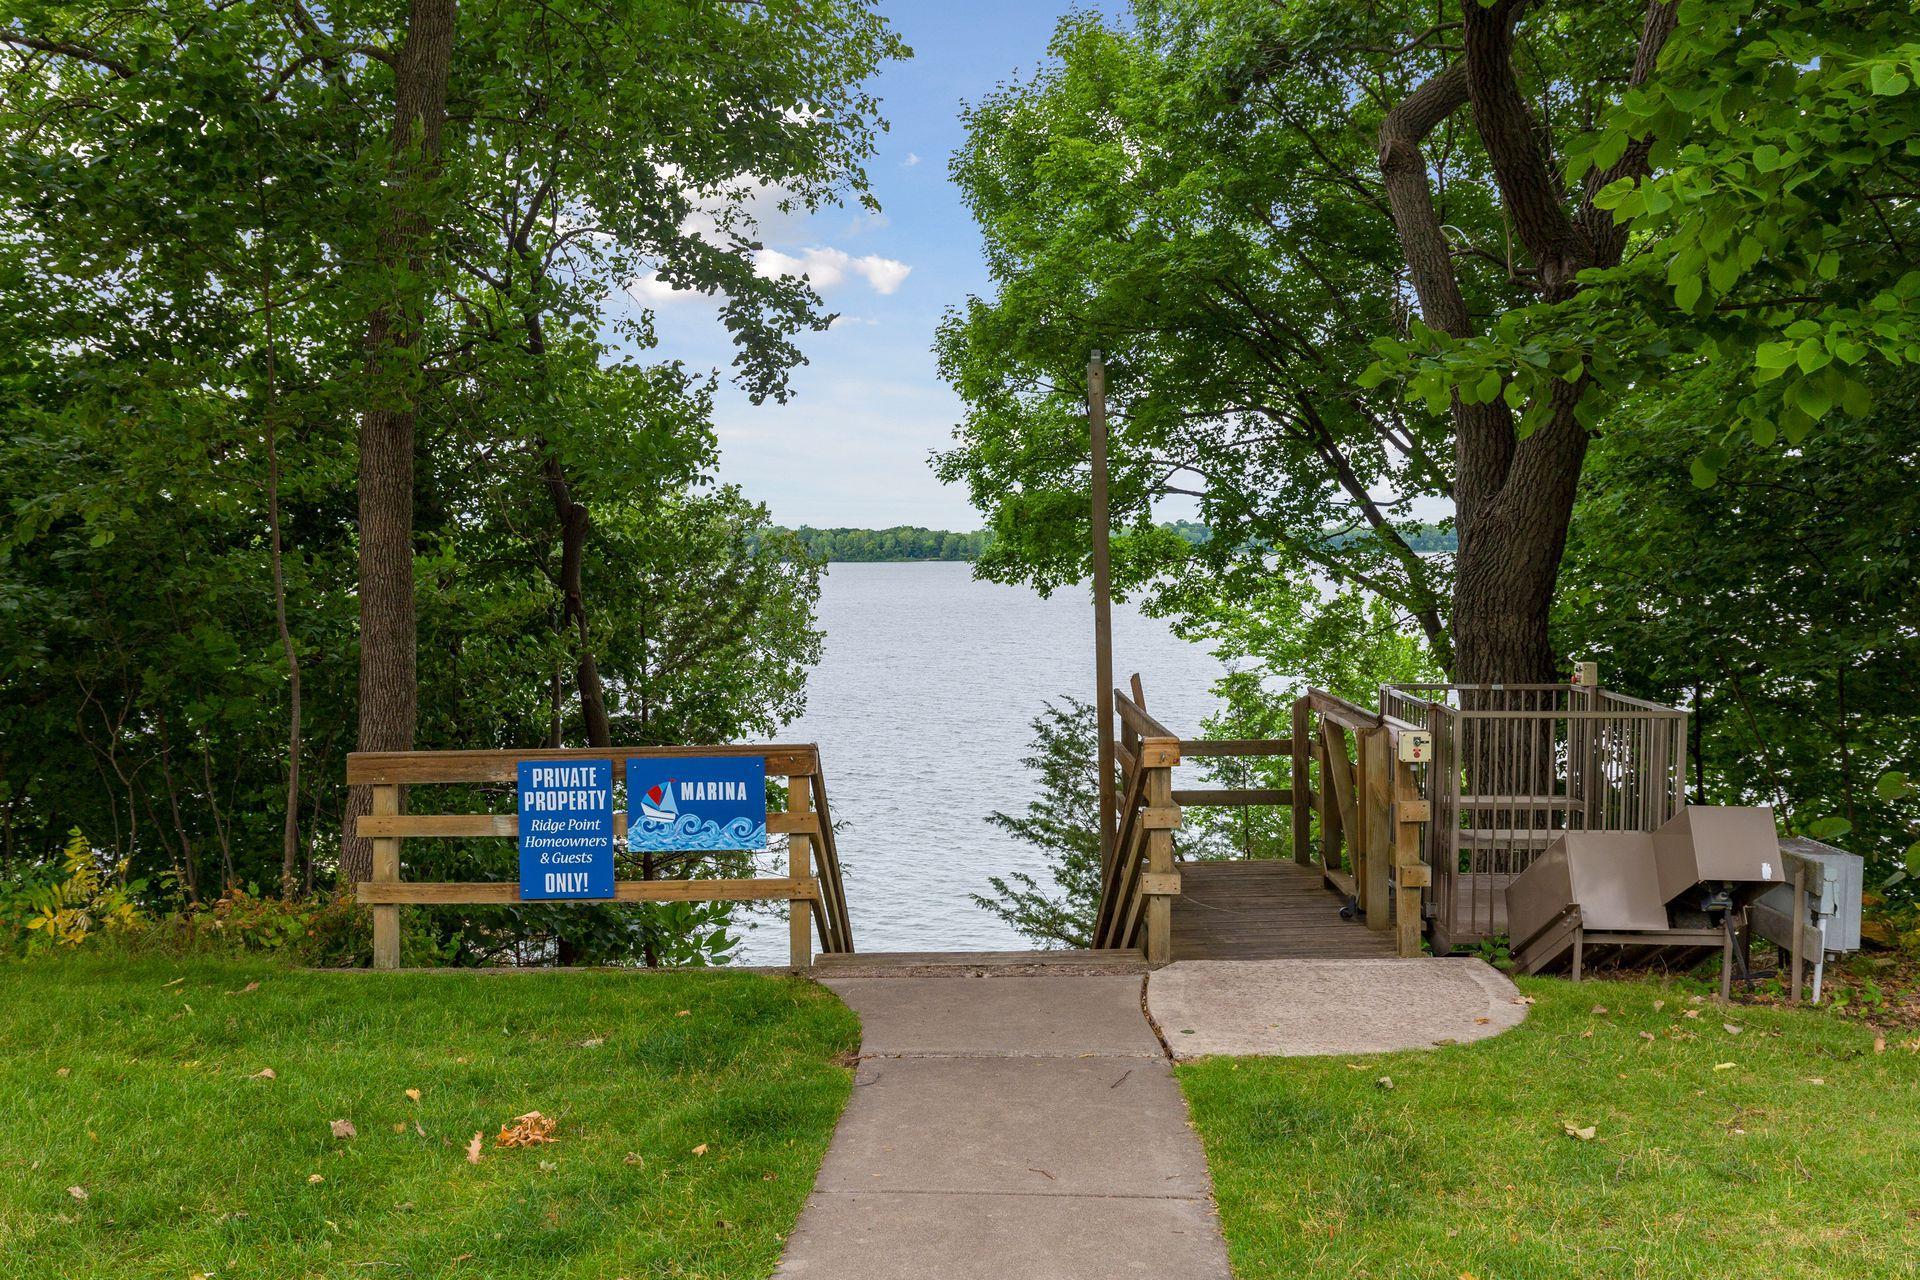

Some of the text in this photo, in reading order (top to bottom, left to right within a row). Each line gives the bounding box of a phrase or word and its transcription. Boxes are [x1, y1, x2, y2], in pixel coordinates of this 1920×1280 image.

[532, 767, 597, 788] PRIVATE
[524, 790, 606, 811] PROPERTY
[681, 782, 747, 801] MARINA
[531, 818, 601, 834] Ridge Point
[525, 836, 607, 848] Homeowners
[540, 852, 593, 864] & Guests
[545, 872, 588, 893] ONLY!
